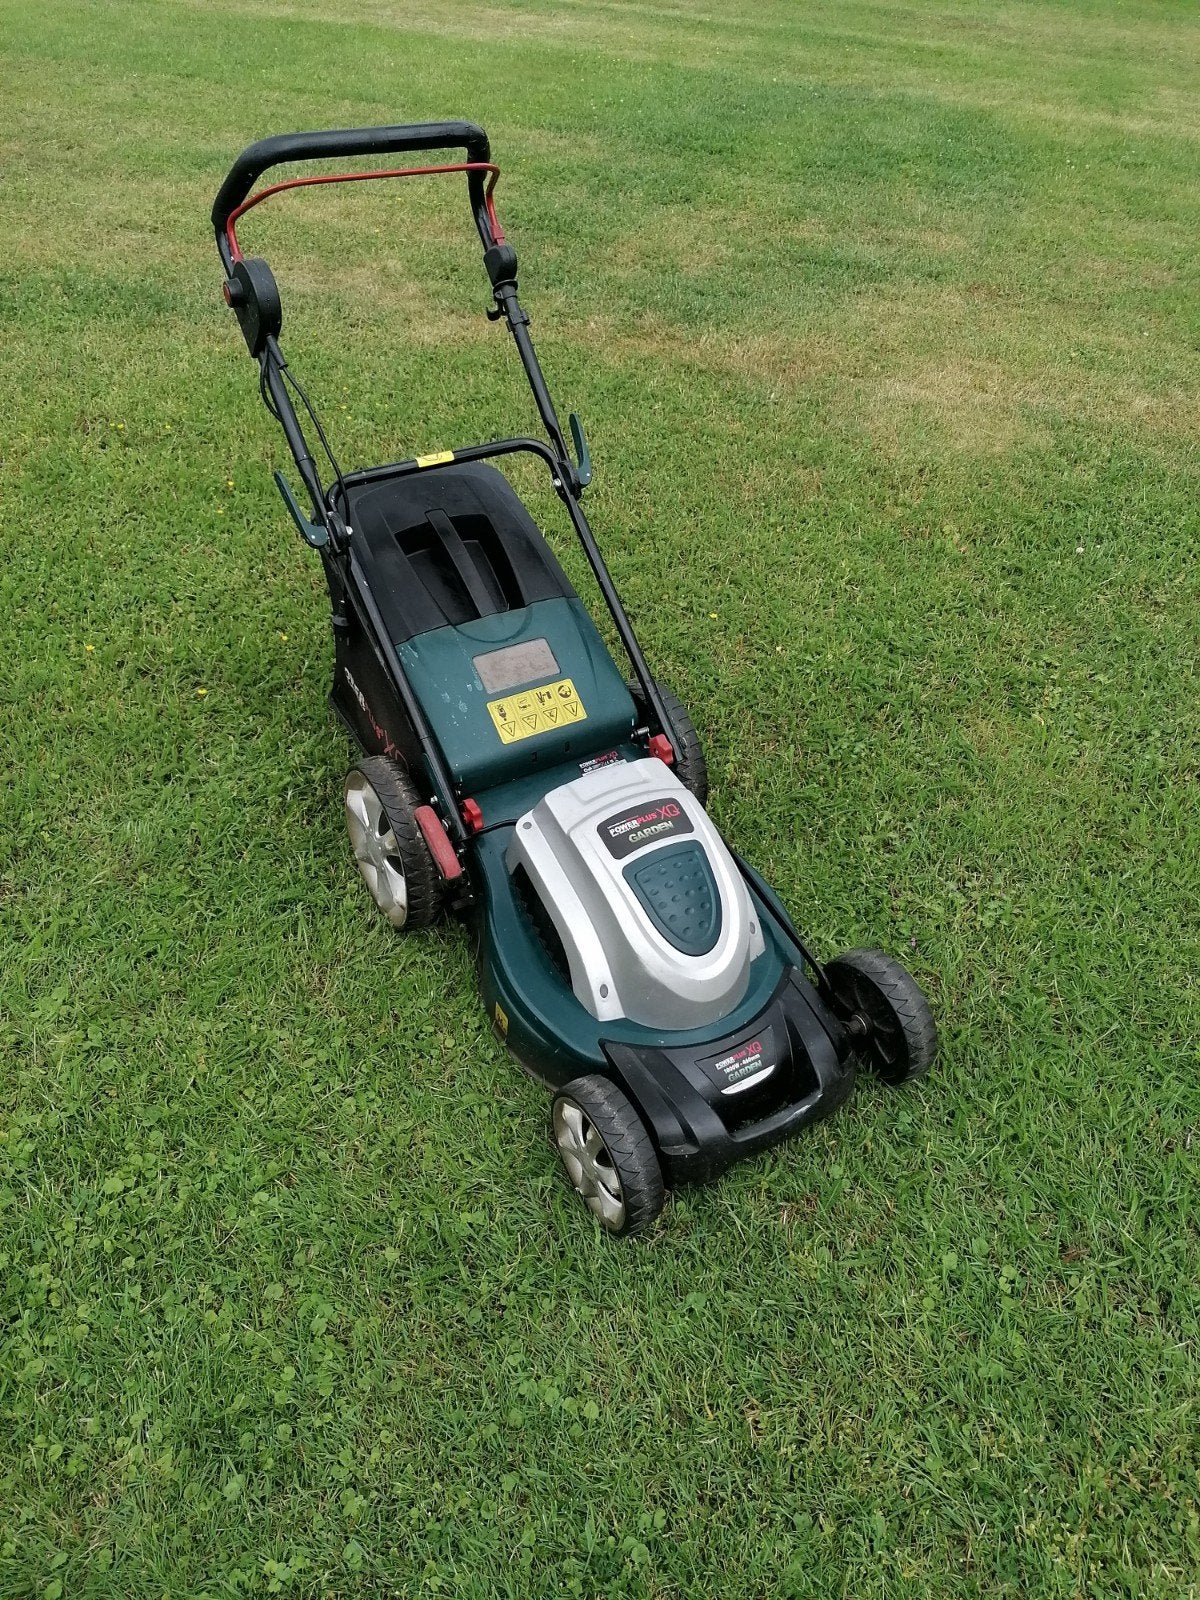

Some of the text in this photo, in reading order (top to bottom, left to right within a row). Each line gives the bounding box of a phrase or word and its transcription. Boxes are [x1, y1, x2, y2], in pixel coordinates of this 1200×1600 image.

[609, 804, 681, 837] POWERPLUS XQ
[628, 821, 674, 843] GARDEN
[746, 1041, 763, 1056] XQ
[728, 1060, 763, 1082] GARDEN
